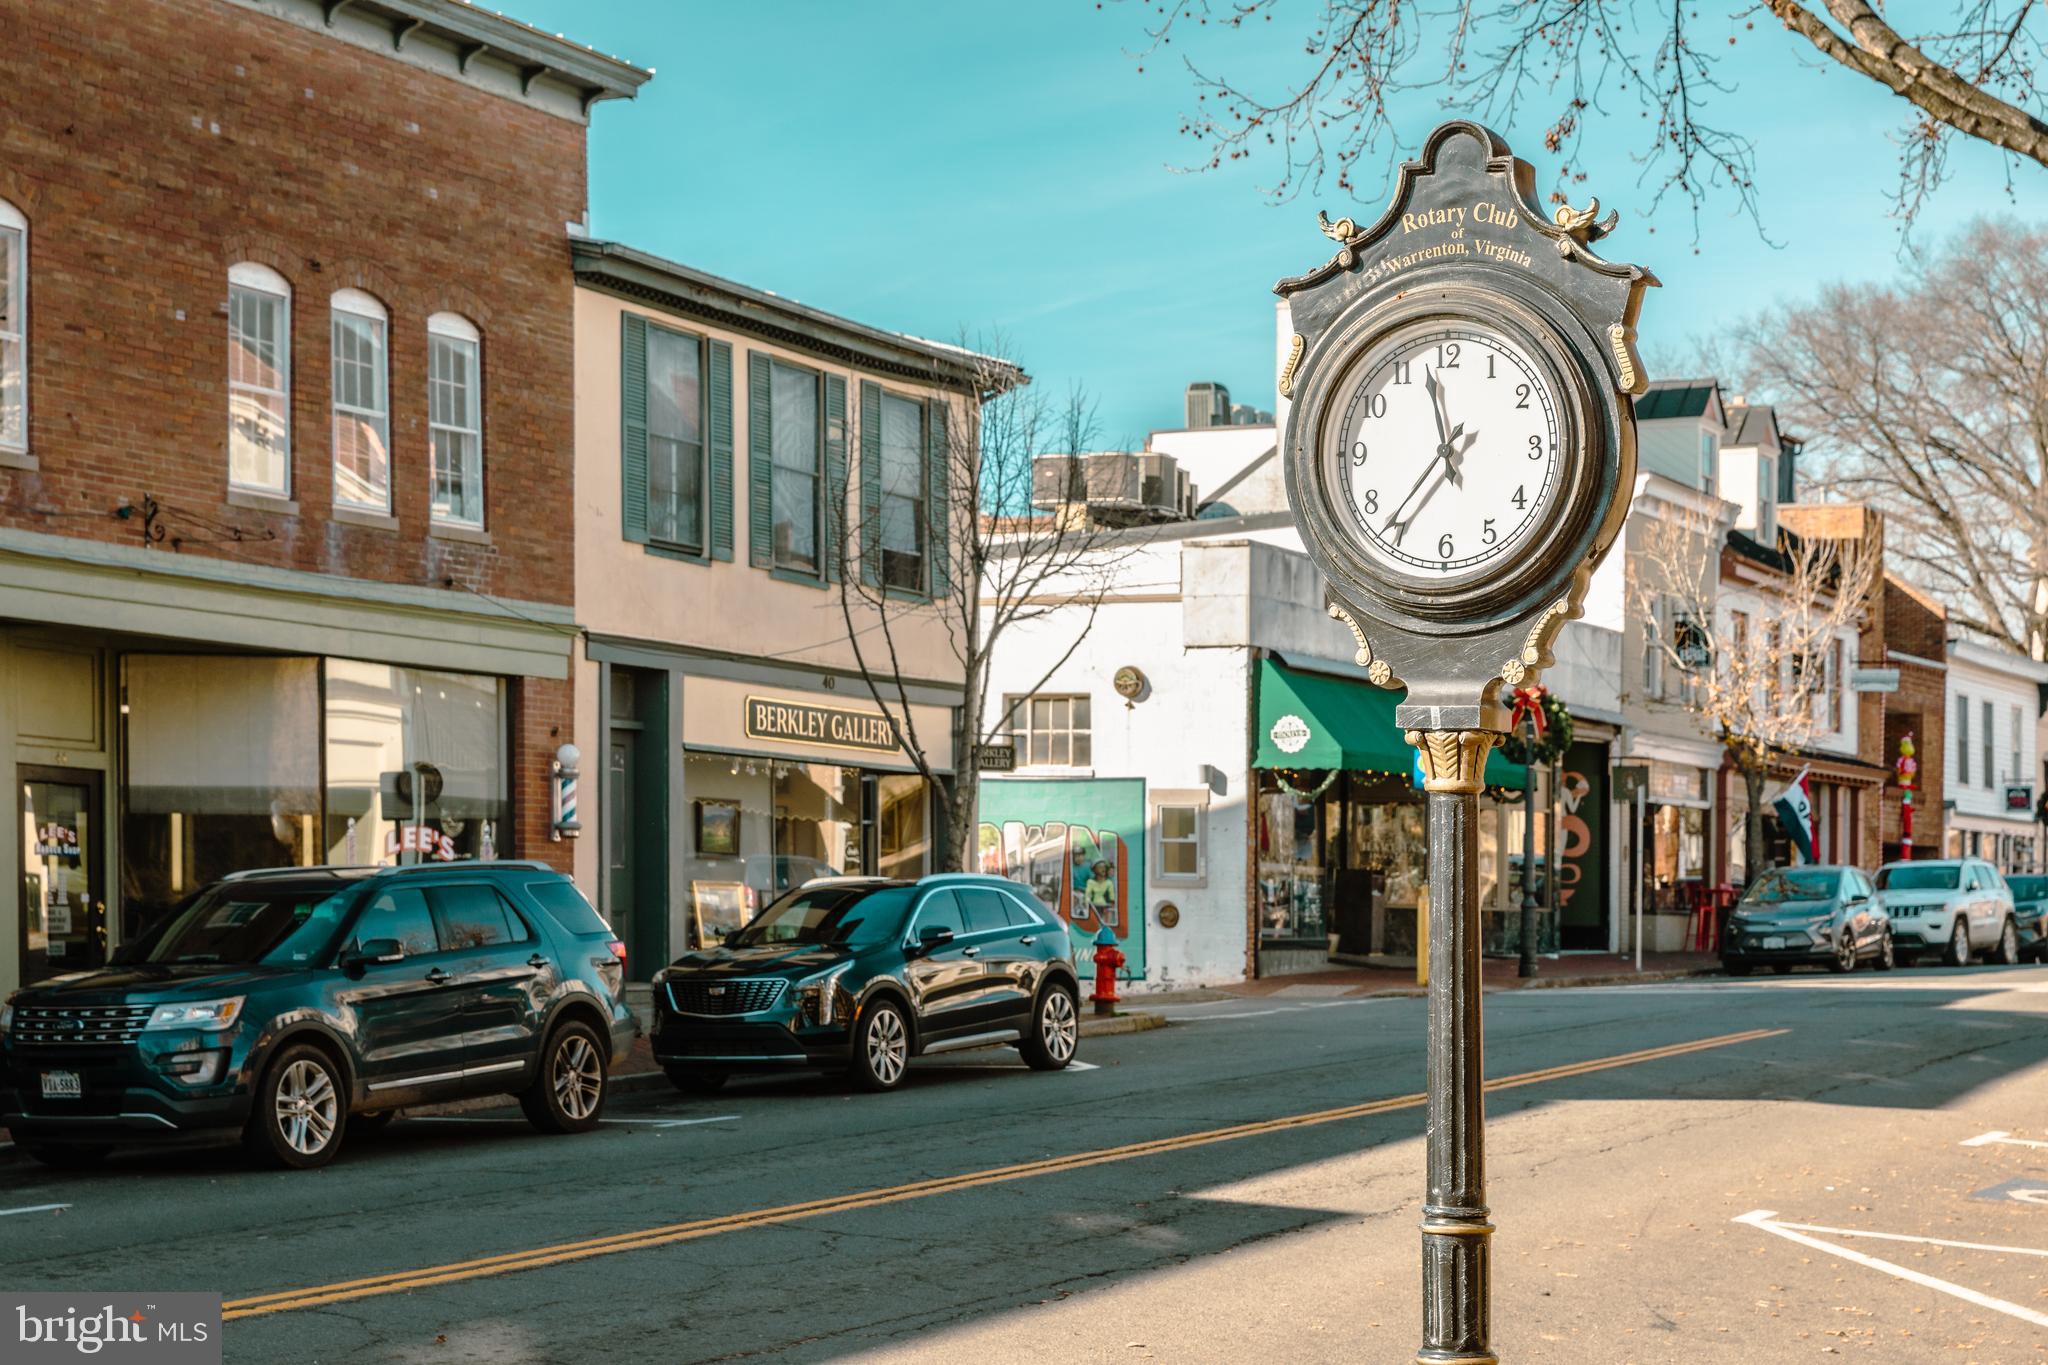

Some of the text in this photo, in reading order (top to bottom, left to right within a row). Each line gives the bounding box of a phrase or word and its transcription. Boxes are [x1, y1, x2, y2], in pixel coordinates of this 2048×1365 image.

[1402, 202, 1519, 235] Rotary Club
[1451, 227, 1465, 239] of
[1386, 239, 1532, 273] Warrenton, Virginia
[1435, 343, 1461, 369] 12
[1486, 354, 1497, 379] 1
[1392, 360, 1412, 385] 11
[1362, 393, 1387, 419] 10
[1515, 383, 1531, 409] 2
[1352, 442, 1368, 467] 9
[1528, 435, 1543, 460] 3
[1364, 489, 1379, 514] 8
[1511, 485, 1528, 510] 4
[1394, 521, 1406, 547] 7
[1482, 518, 1497, 545] 5
[1438, 533, 1454, 559] 6
[822, 675, 835, 690] 40
[756, 704, 896, 746] BERKLEY GALLERY
[978, 758, 1011, 769] ALLERY
[39, 826, 77, 844] LEE'S
[385, 826, 455, 862] LEE'S
